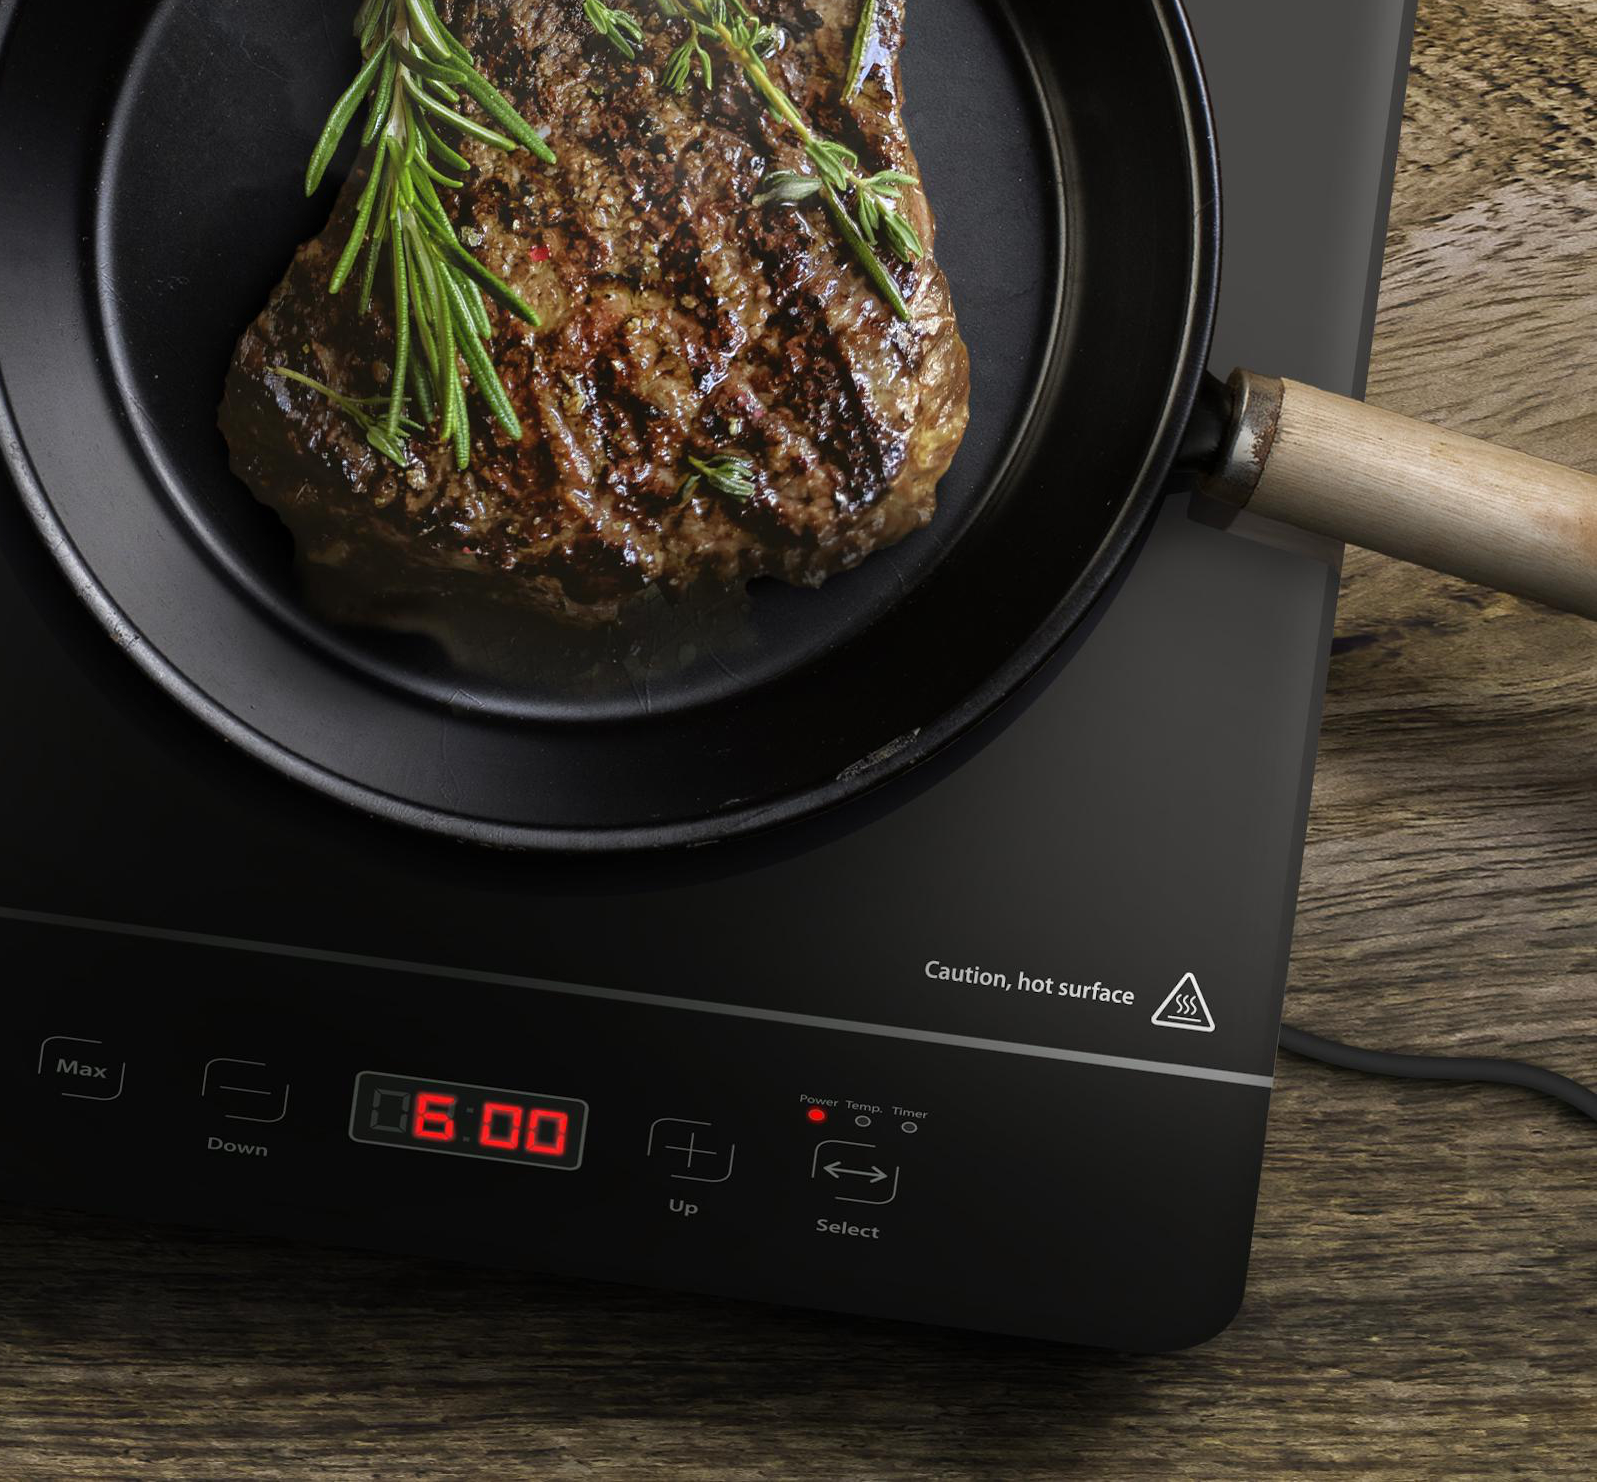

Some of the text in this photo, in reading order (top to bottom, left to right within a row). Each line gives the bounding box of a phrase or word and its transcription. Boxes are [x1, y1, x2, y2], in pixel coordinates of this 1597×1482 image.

[924, 960, 1135, 1006] Caution, hot surface
[56, 1058, 108, 1079] Max
[798, 1093, 929, 1120] Power Temp. Timer
[207, 1136, 268, 1157] Down
[669, 1198, 699, 1217] Up
[816, 1218, 880, 1239] Select
